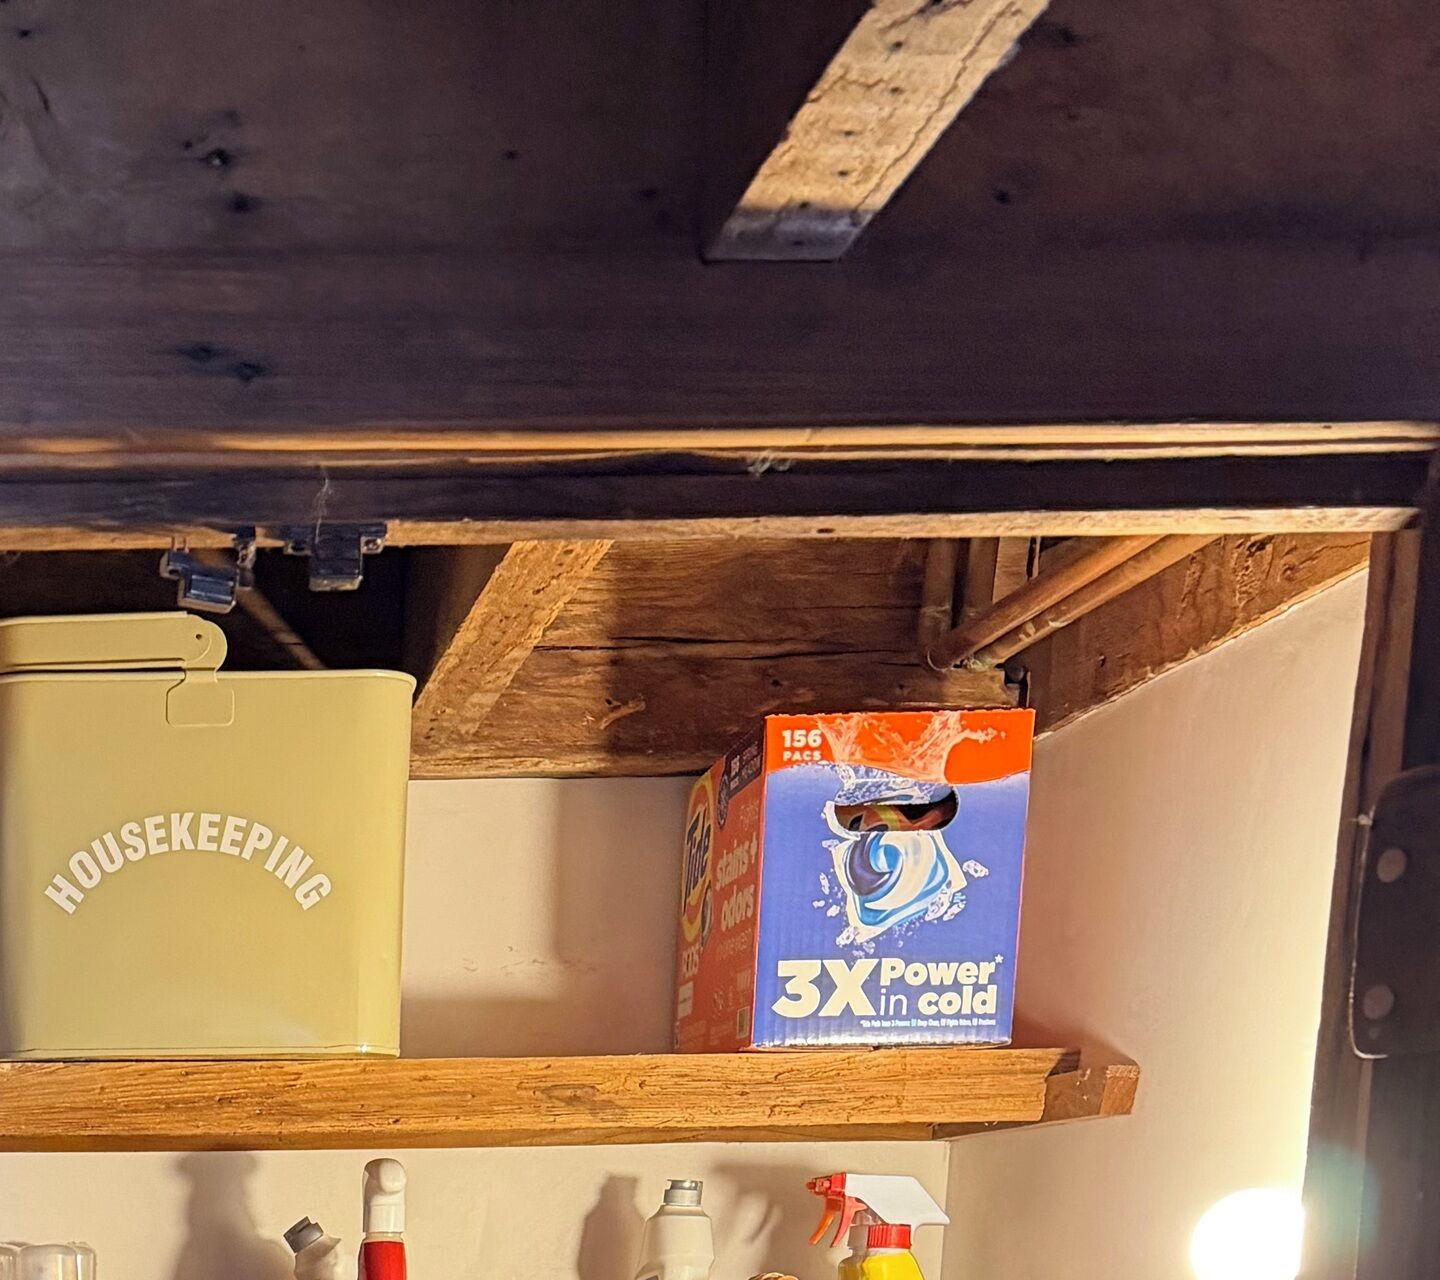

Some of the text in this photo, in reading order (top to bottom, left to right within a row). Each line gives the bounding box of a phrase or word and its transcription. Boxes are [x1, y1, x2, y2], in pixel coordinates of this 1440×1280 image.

[781, 729, 822, 748] 156
[783, 750, 822, 761] PACS
[44, 812, 332, 915] HOUSEKEEPING
[771, 958, 880, 1018] 3X
[879, 984, 998, 1016] in cold
